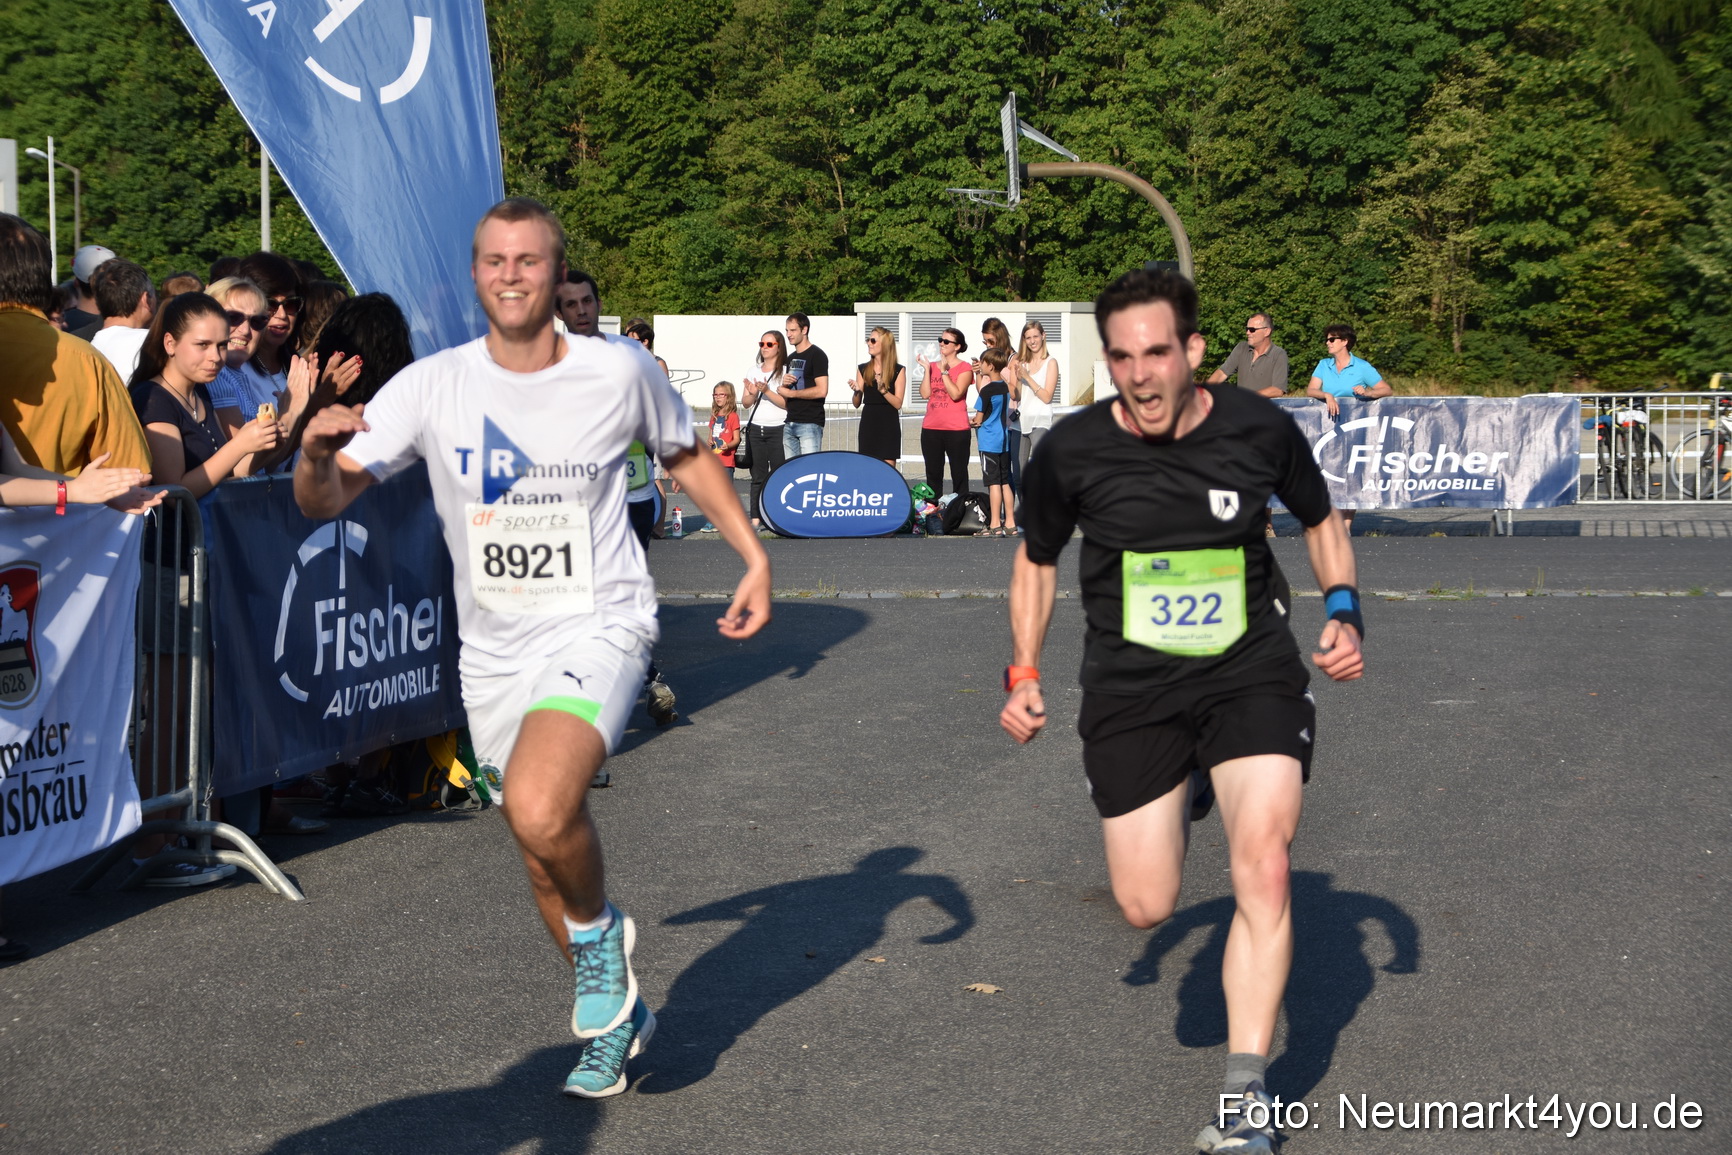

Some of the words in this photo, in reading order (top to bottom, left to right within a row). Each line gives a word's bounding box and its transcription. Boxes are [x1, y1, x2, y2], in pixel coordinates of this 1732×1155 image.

[1347, 444, 1509, 474] Fischer
[1361, 478, 1496, 491] AUTOMOBILE
[502, 489, 562, 505] Team
[802, 489, 893, 508] Fischer
[472, 510, 570, 530] df-sports
[812, 509, 888, 518] AUTOMOBILE
[483, 542, 573, 579] 8921
[477, 583, 589, 595] www.df-sports.de
[1151, 592, 1223, 626] 322
[322, 663, 440, 720] AUTOMOBILE
